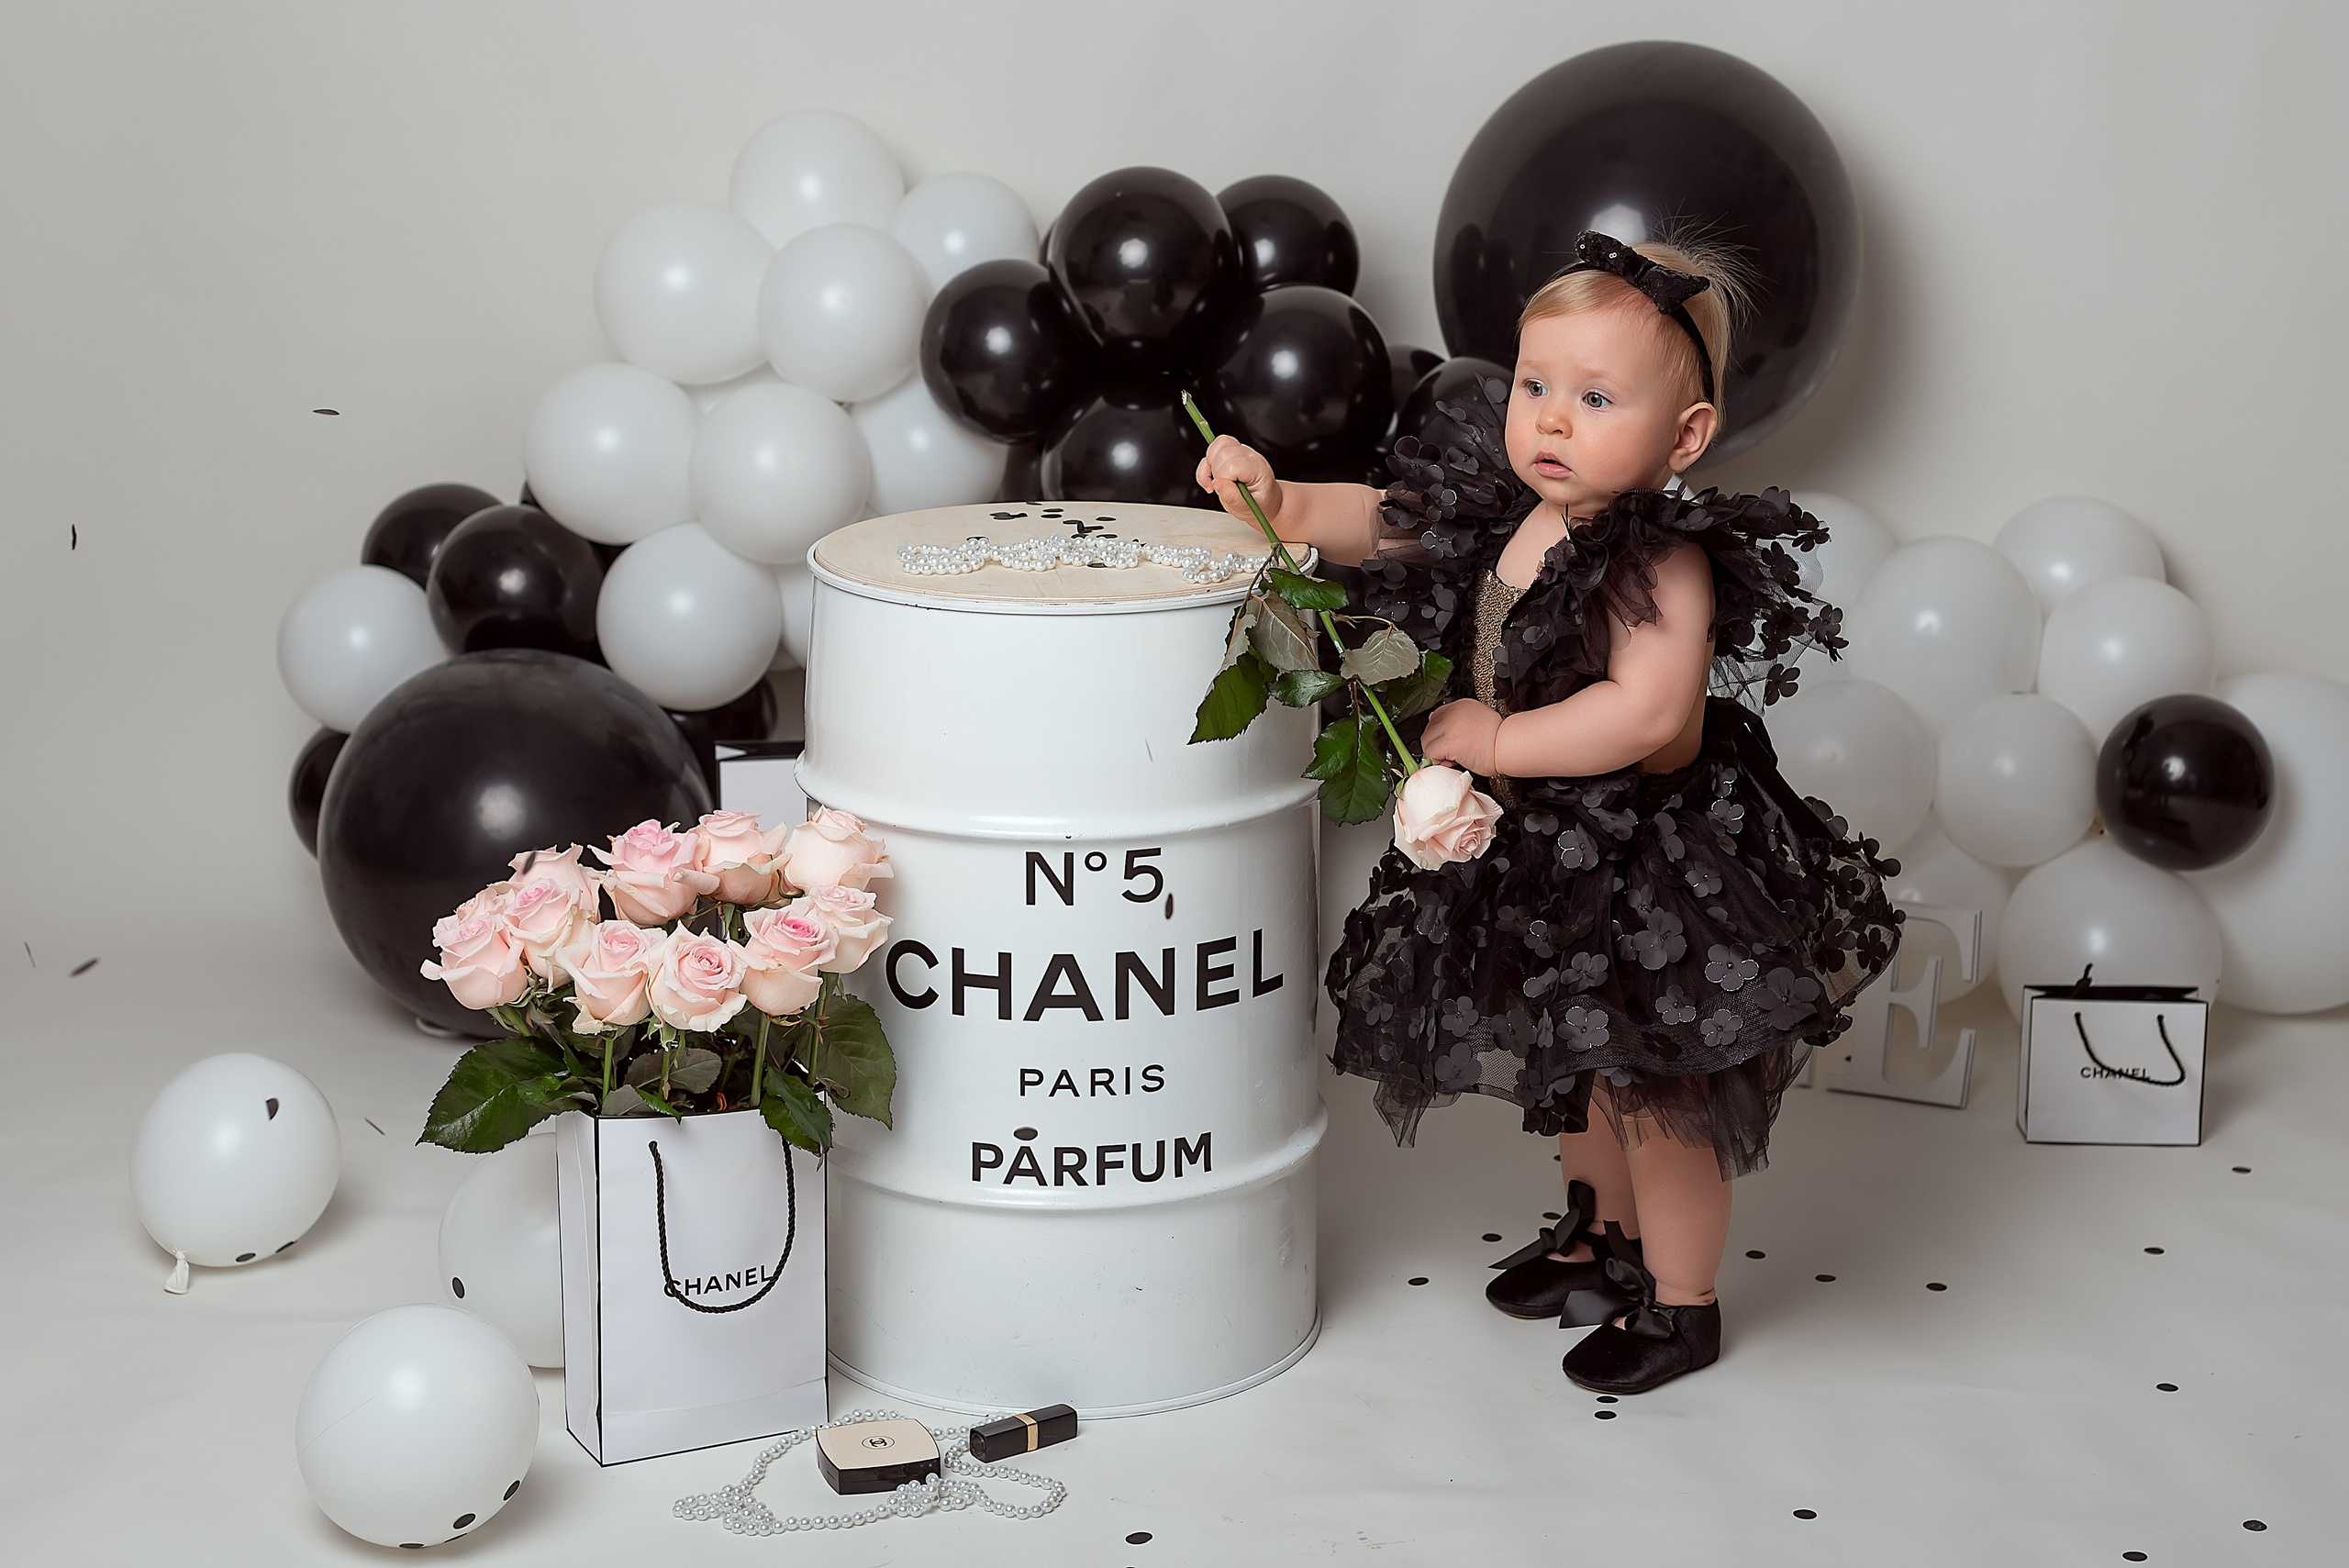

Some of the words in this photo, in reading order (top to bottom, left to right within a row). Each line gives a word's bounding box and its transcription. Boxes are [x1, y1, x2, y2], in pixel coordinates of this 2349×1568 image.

[885, 929, 1284, 1022] CHANEL
[1019, 1064, 1165, 1097] PARIS
[972, 1131, 1212, 1187] PARFUM
[663, 1264, 773, 1297] CHANEL
